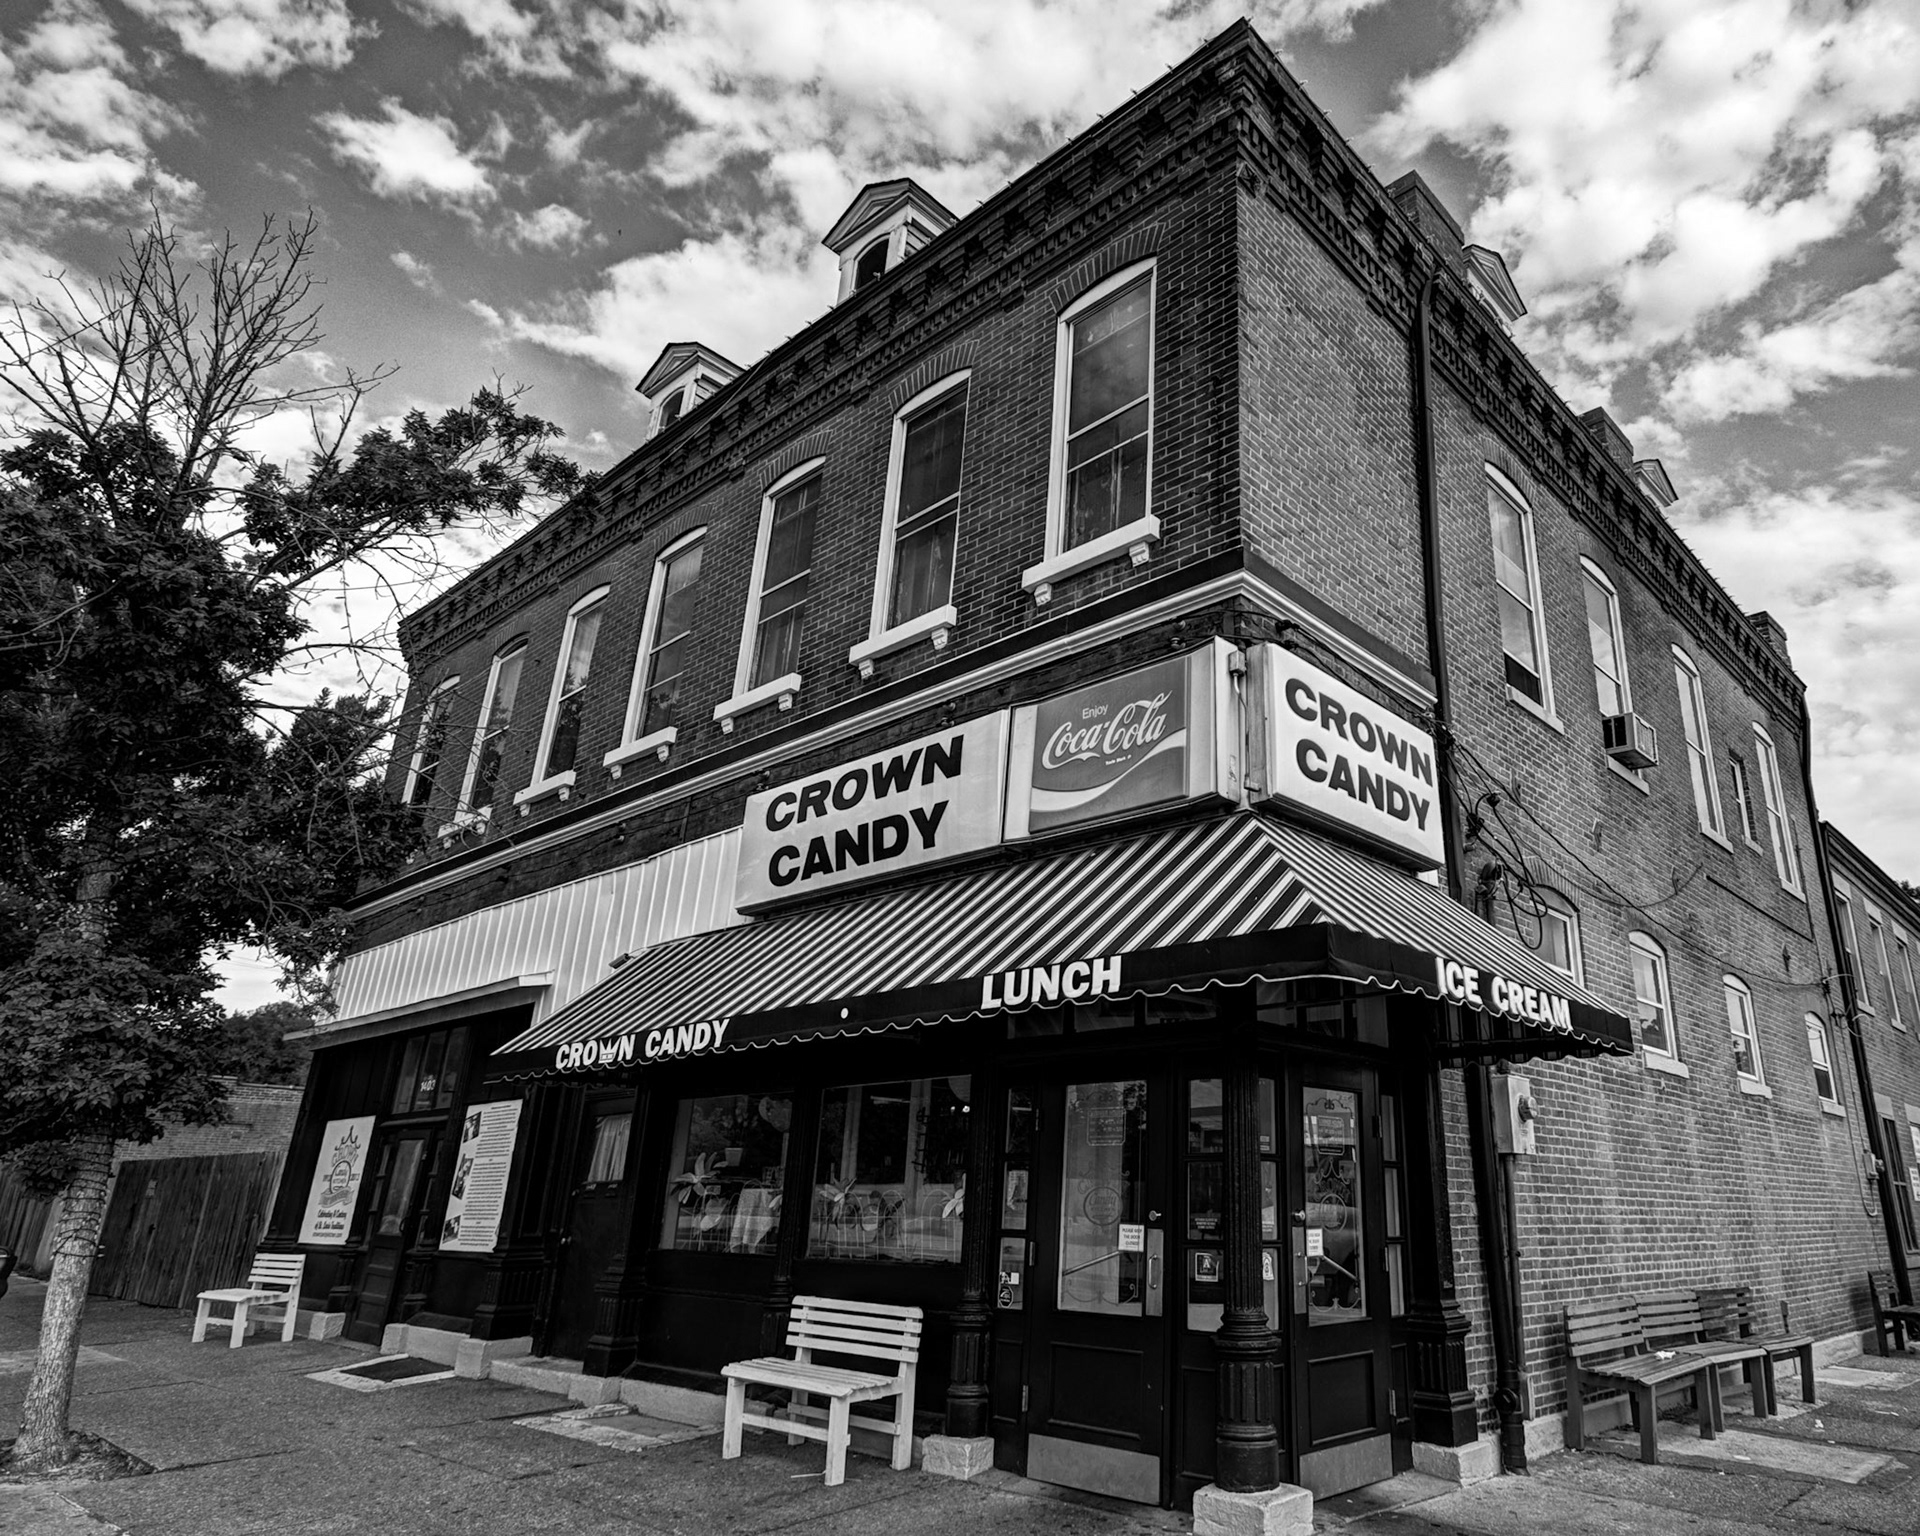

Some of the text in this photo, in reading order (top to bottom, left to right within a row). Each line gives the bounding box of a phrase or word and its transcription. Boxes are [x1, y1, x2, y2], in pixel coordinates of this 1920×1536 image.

[1042, 690, 1172, 769] Coca-Cola
[1082, 704, 1109, 720] Enjoy
[1285, 677, 1433, 788] CROWN
[765, 734, 964, 832] CROWN
[1295, 738, 1430, 832] CANDY
[768, 800, 949, 887] CANDY
[981, 955, 1122, 1010] LUNCH
[1435, 957, 1574, 1031] ICE CREAM
[555, 1018, 730, 1070] CROWN CANDY
[420, 1079, 436, 1092] 1403
